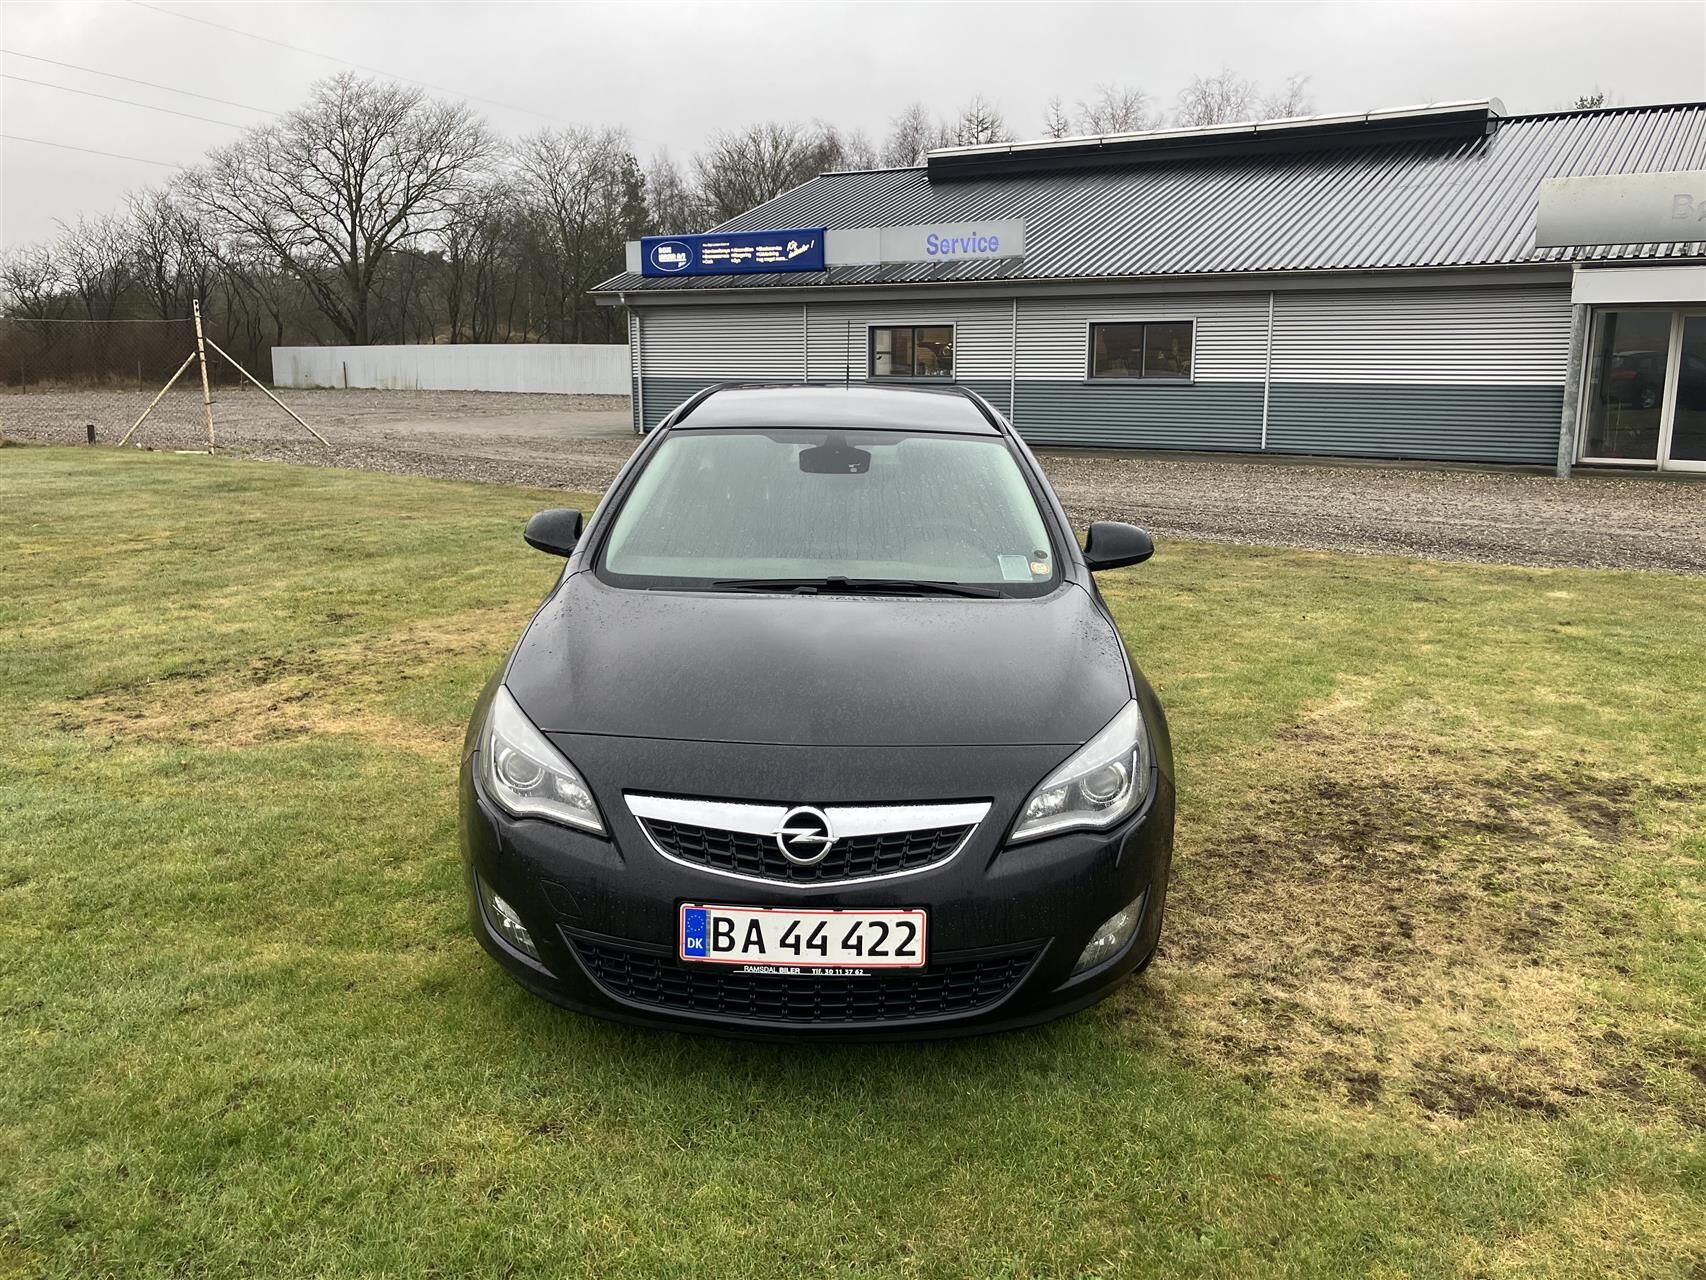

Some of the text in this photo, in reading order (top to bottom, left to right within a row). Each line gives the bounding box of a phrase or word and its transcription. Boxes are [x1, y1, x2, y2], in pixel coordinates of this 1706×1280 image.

[926, 232, 999, 255] Service
[687, 937, 703, 949] DK
[712, 917, 916, 957] BA 44 422
[743, 965, 778, 974] RAMSDAL
